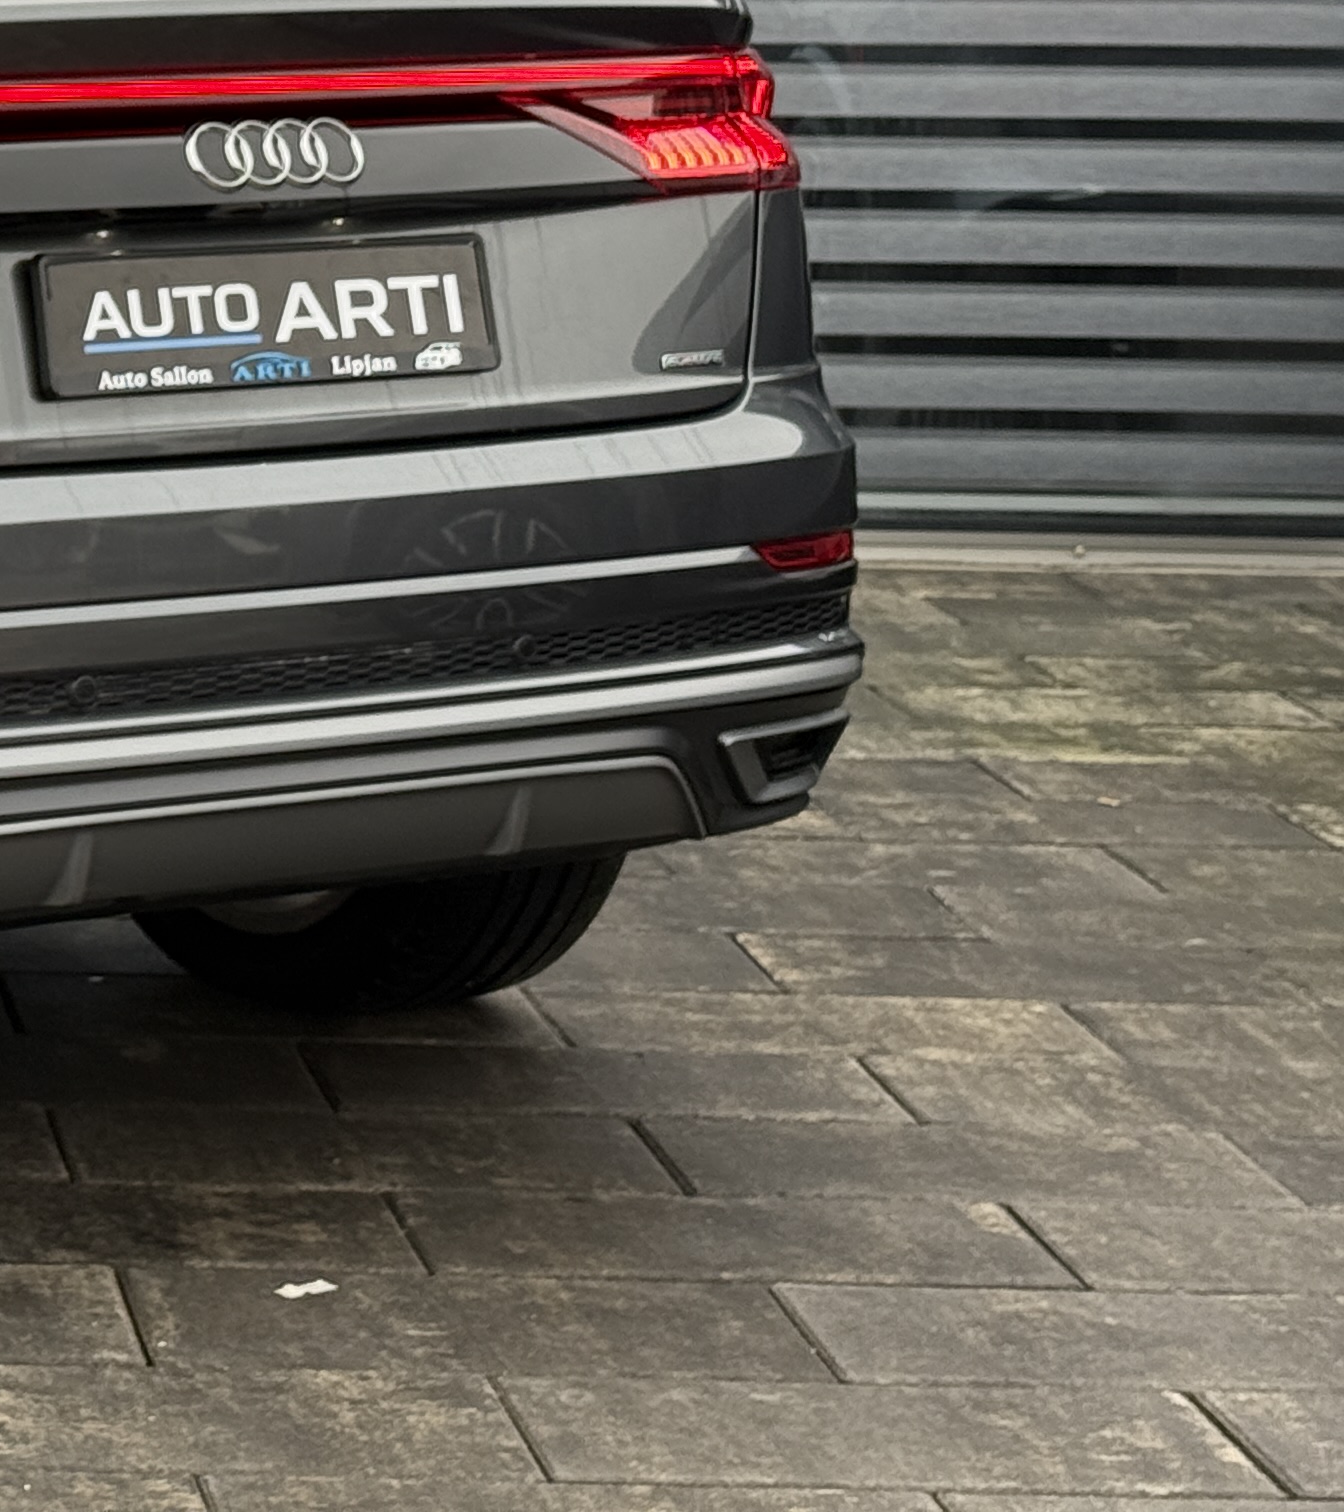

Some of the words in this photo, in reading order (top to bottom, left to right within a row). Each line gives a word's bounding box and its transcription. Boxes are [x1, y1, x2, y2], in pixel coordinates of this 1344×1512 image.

[83, 283, 261, 341] AUTO
[275, 274, 465, 343] ARTI
[98, 369, 148, 391] Auto
[232, 360, 313, 383] ARTI
[330, 354, 398, 379] Lipjan
